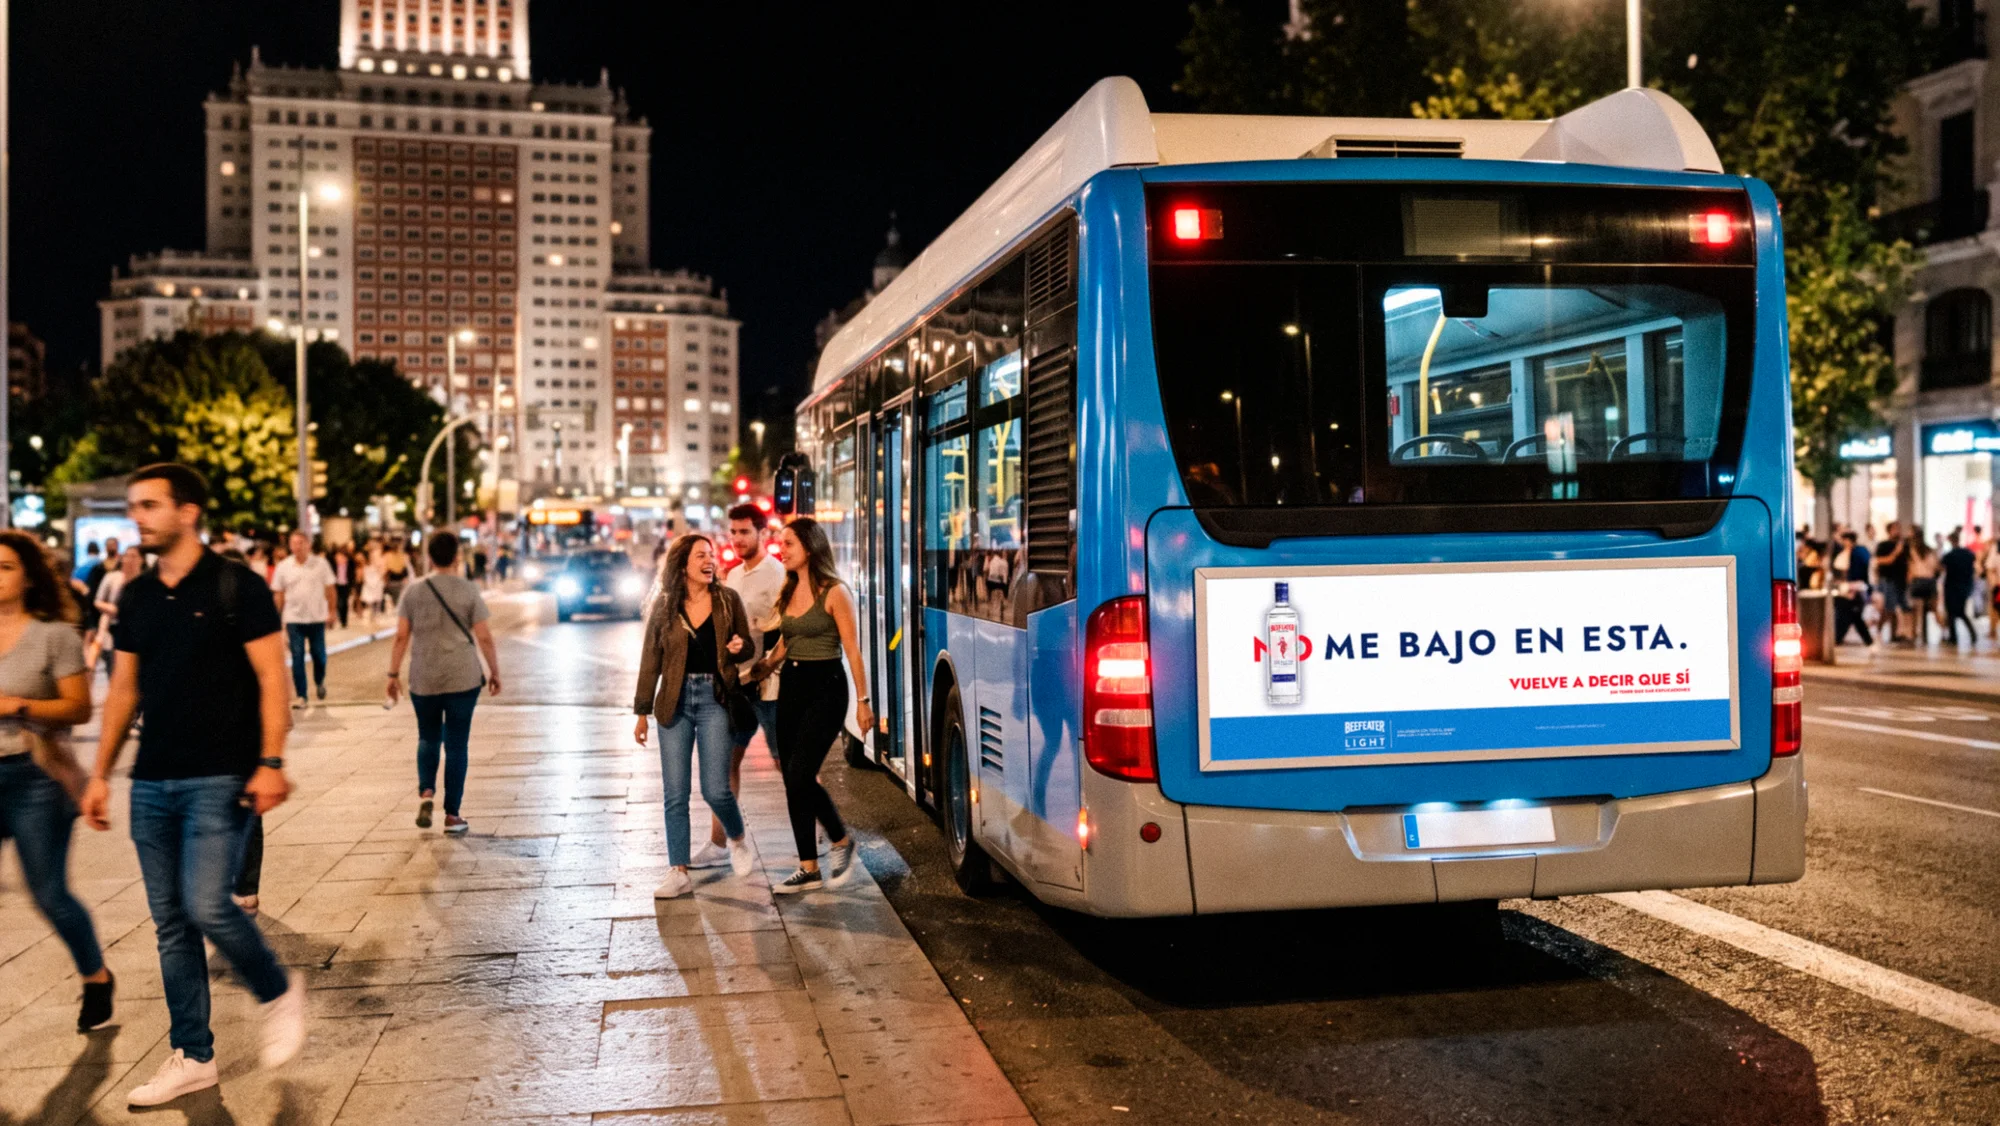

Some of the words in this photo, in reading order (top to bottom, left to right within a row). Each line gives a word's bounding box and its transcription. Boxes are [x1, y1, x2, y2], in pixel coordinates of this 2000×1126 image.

[1325, 633, 1379, 660] ME
[1399, 629, 1496, 664] BAJO
[1515, 627, 1563, 654] EN
[1583, 624, 1687, 652] ESTA.
[1508, 676, 1568, 690] VUELVE
[1572, 676, 1584, 688] A
[1588, 674, 1634, 688] DECIR
[1638, 672, 1671, 686] QUE
[1675, 668, 1690, 684] SÍ
[1344, 720, 1385, 734] BEEFEATER
[1344, 737, 1385, 747] LIGHT
